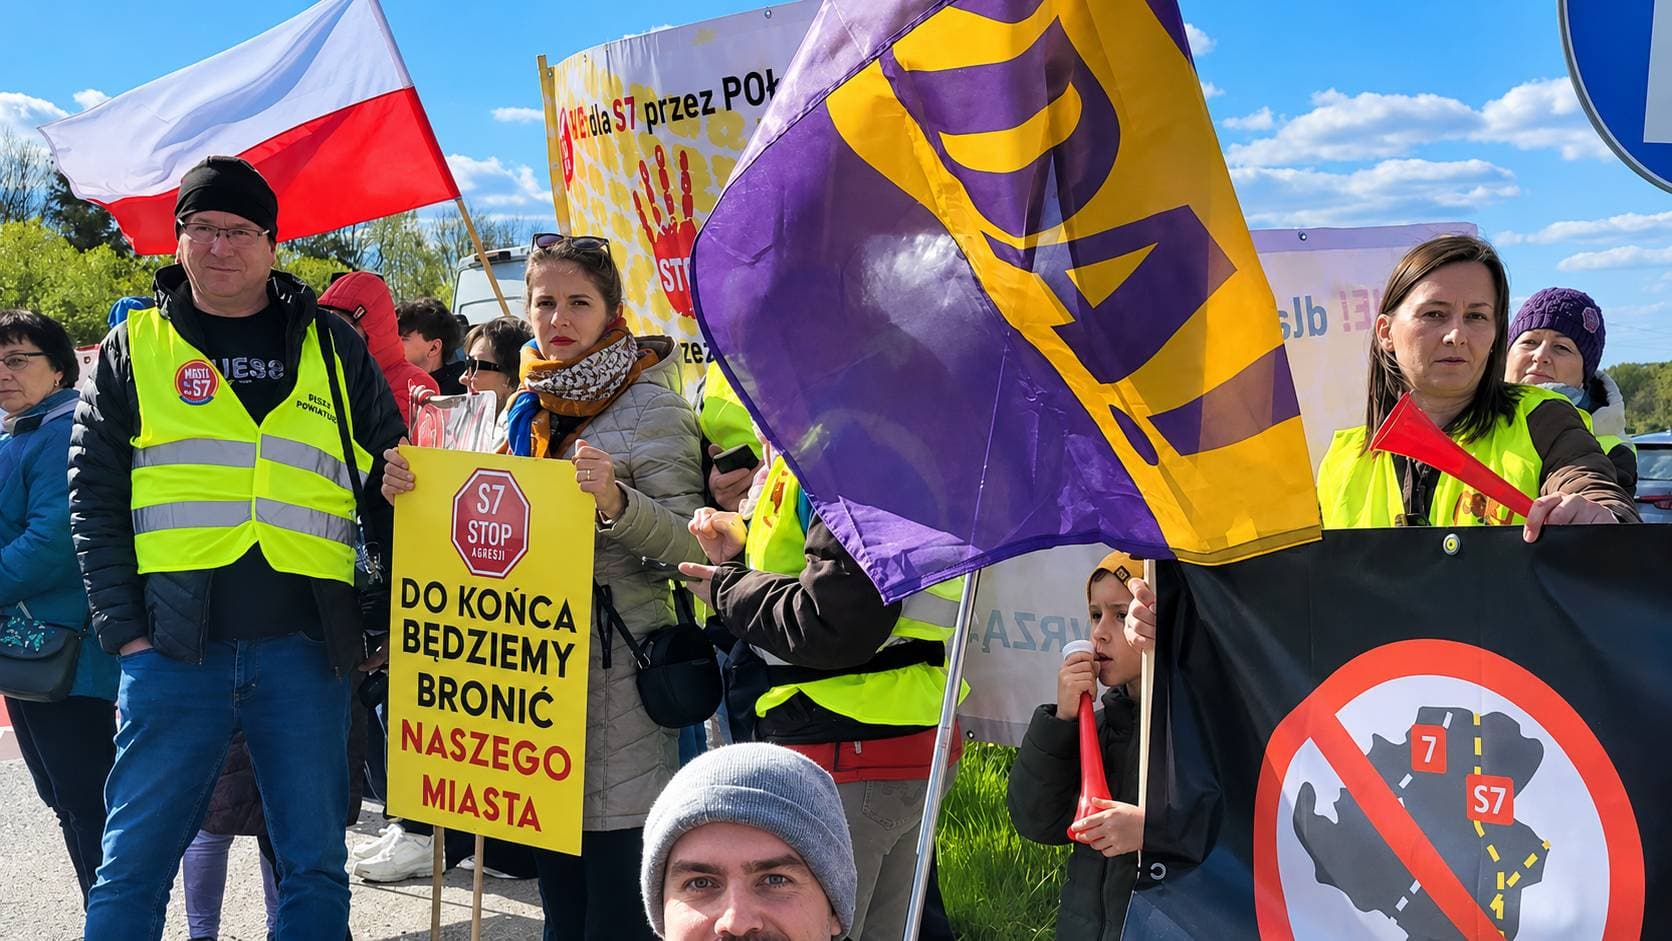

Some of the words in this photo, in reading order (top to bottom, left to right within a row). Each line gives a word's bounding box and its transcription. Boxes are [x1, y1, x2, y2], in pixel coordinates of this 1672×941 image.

[590, 103, 612, 137] dla
[612, 96, 637, 133] S7
[643, 89, 716, 135] przez
[722, 68, 781, 111] POŁ
[659, 257, 691, 293] ST
[681, 342, 716, 364] zez
[193, 379, 211, 397] S7
[476, 482, 506, 515] S7
[467, 520, 513, 547] STOP
[471, 547, 506, 561] AGRESJI
[401, 577, 448, 614] DO
[458, 585, 577, 634] KOŃCA
[402, 618, 576, 679] BĘDZIEMY
[417, 671, 554, 729] BRONIĆ
[401, 718, 572, 782] NASZEGO
[1420, 735, 1438, 764] 7
[422, 773, 542, 833] MIASTA
[1473, 784, 1507, 816] S7
